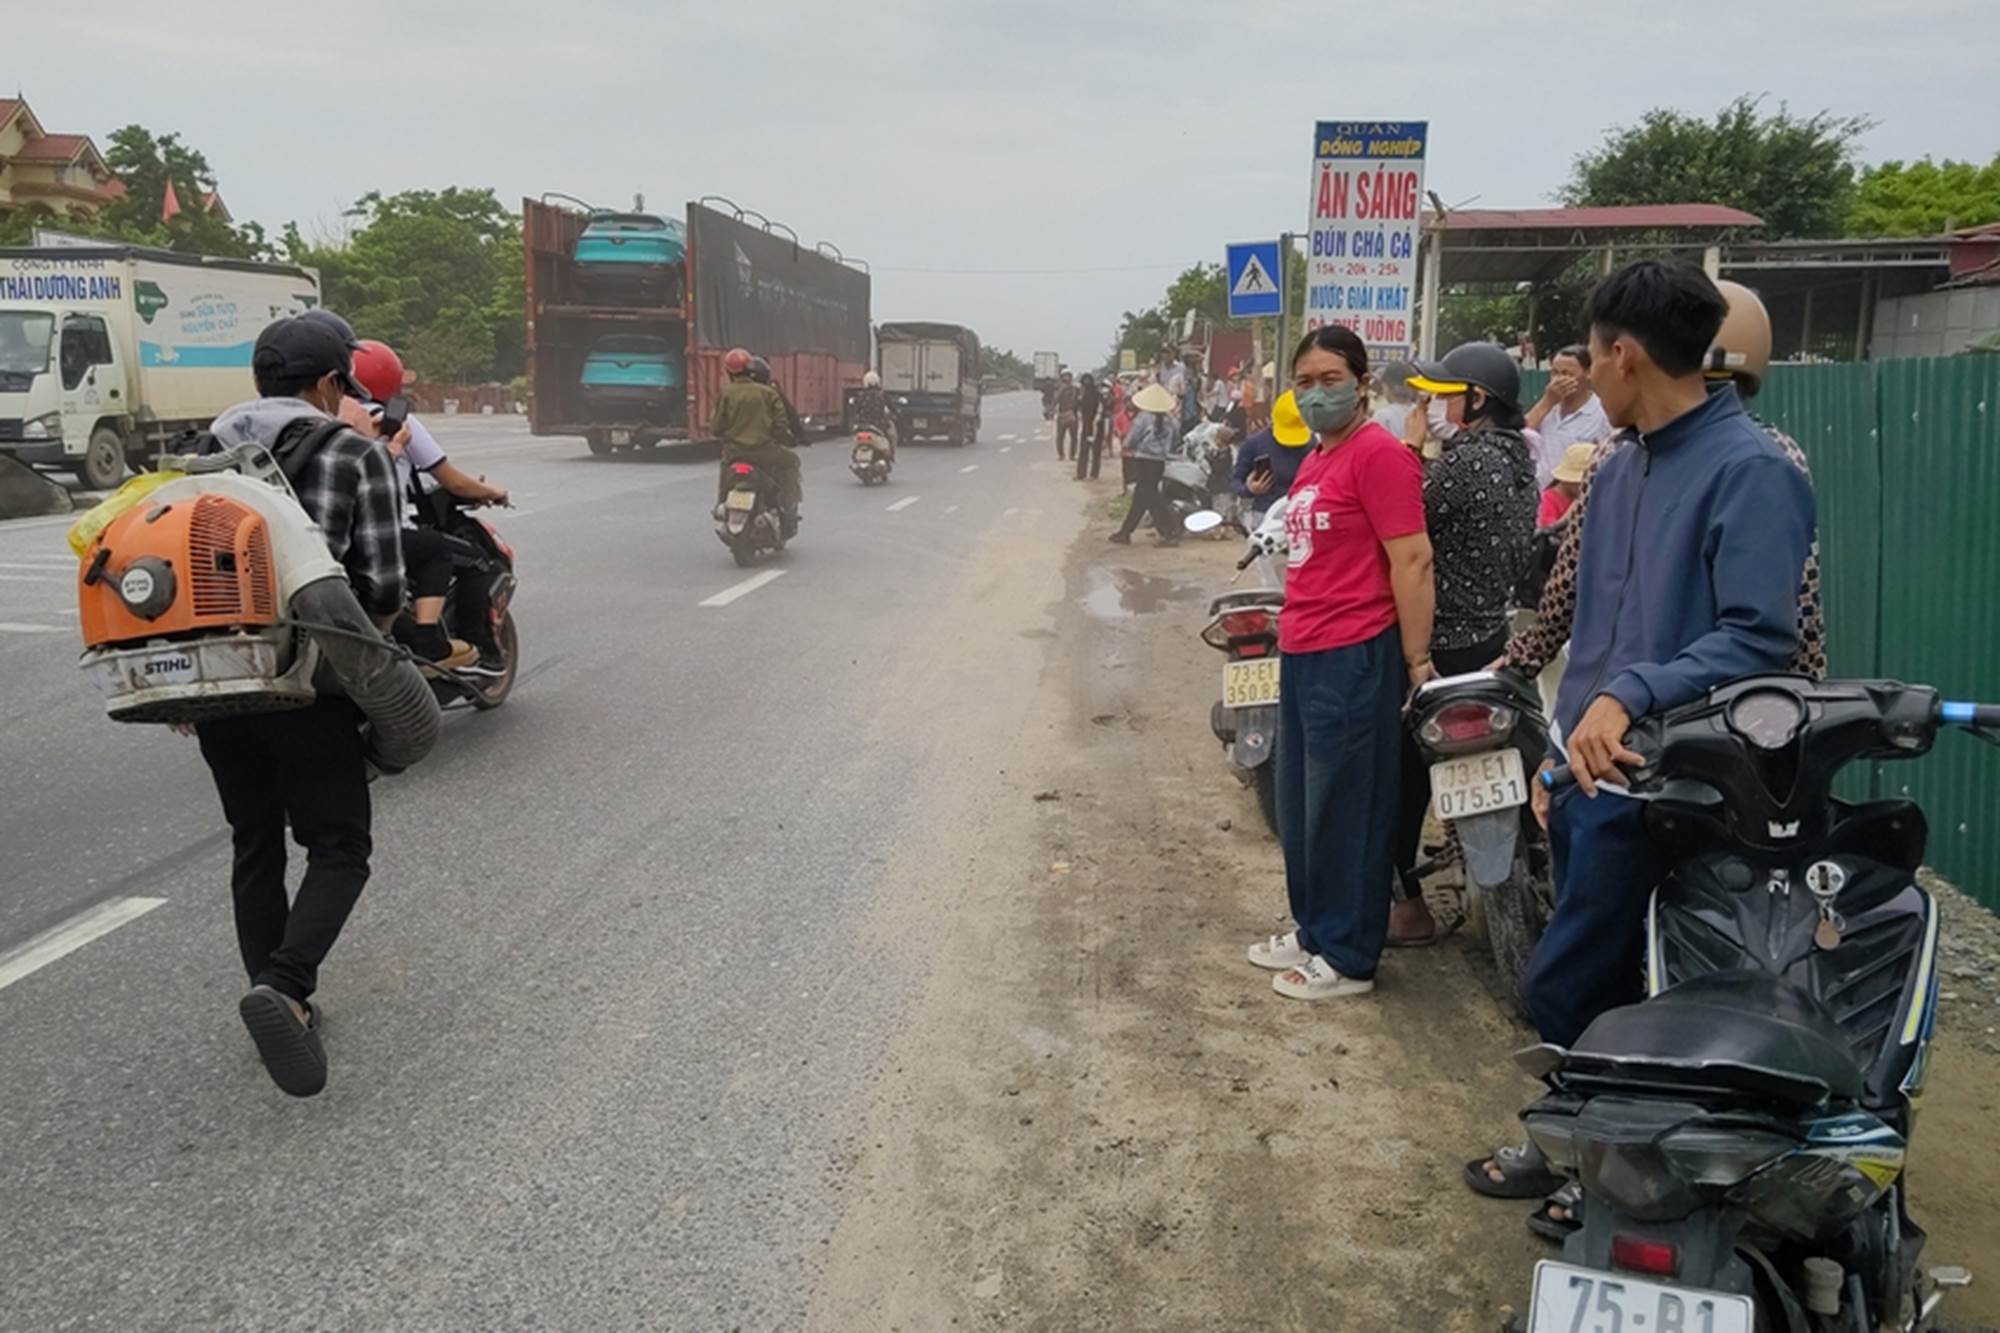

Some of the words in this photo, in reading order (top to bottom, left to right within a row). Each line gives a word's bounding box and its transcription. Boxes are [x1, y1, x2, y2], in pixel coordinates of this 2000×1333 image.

[1316, 162, 1349, 219] ĂN
[1355, 162, 1418, 220] SÁNG
[1313, 225, 1346, 257] BÚN
[1316, 262, 1335, 275] 15k
[1346, 262, 1367, 276] 20k
[1378, 262, 1399, 276] 25k
[90, 276, 121, 300] ANH
[145, 659, 191, 676] STIHL
[1440, 780, 1519, 814] 075.51
